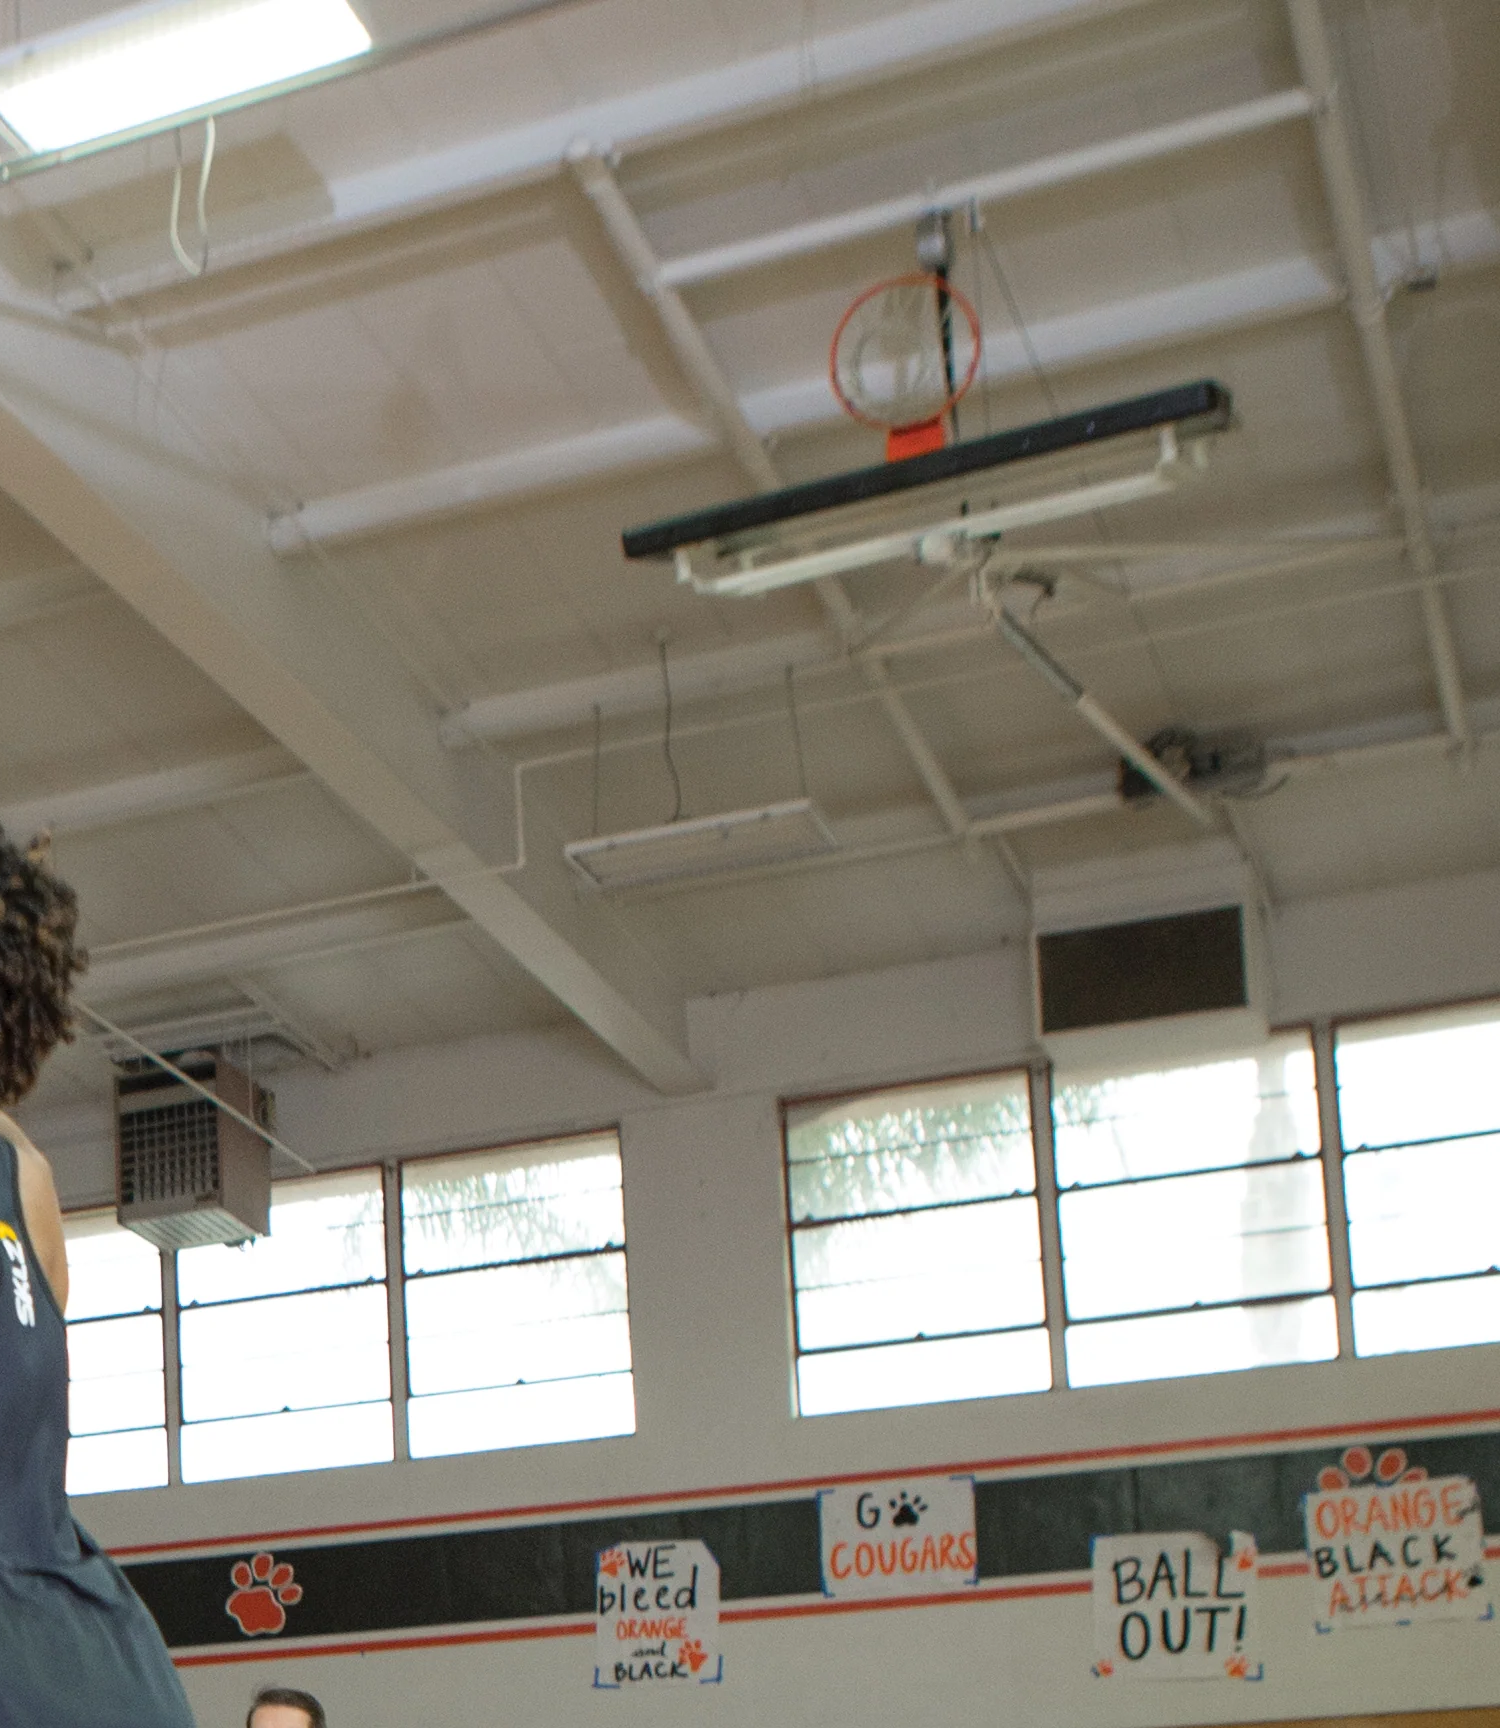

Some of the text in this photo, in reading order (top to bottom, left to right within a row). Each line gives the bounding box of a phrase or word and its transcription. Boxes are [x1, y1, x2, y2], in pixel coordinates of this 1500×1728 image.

[1, 1238, 36, 1328] SKLZ
[1315, 1483, 1464, 1539] ORANGE
[626, 1543, 677, 1579] WE
[829, 1530, 976, 1580] COUGARS
[1112, 1547, 1245, 1605] BALL
[1314, 1534, 1457, 1578] BLACK
[599, 1562, 699, 1615] bleed
[1328, 1567, 1473, 1617] ATTACK
[615, 1616, 690, 1641] ORANGE
[631, 1640, 667, 1657] and
[1119, 1604, 1248, 1661] OUT!
[613, 1660, 689, 1682] BLACK
